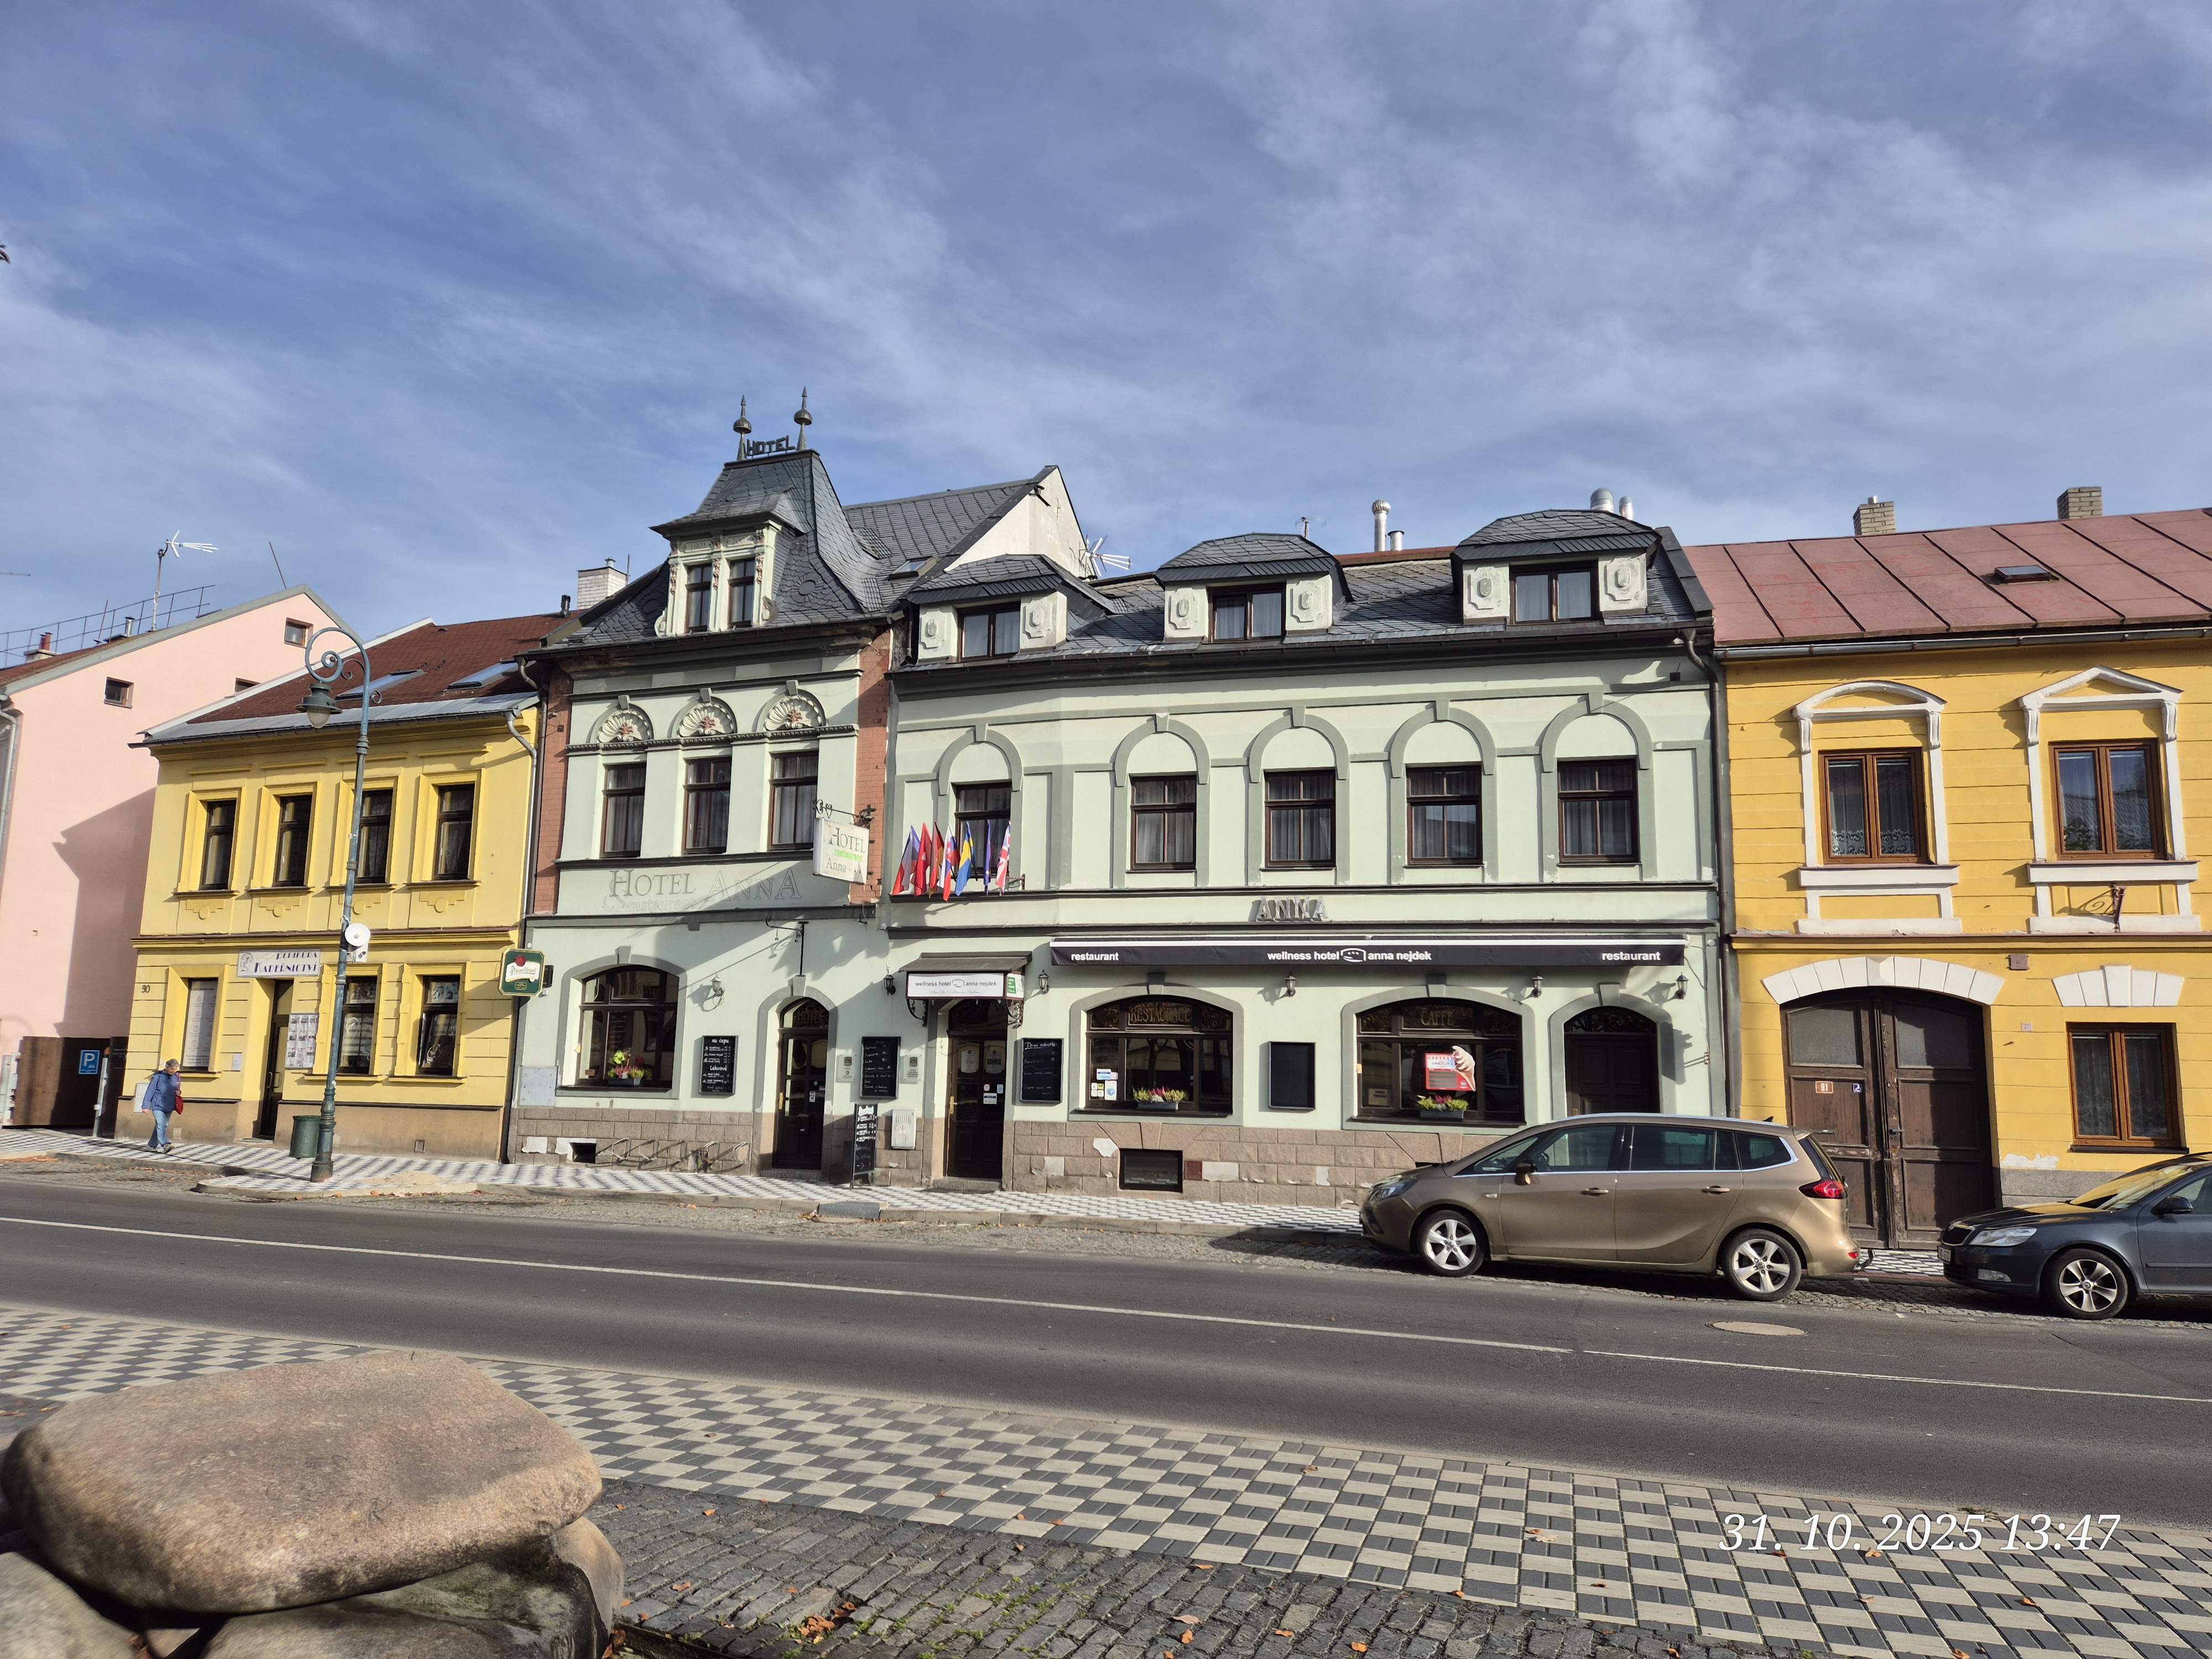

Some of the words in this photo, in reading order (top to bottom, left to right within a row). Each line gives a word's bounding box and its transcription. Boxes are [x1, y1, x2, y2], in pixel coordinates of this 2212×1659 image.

[747, 435, 796, 457] HOTEL
[828, 825, 866, 853] HOTEL
[834, 849, 863, 862] restaurant
[826, 857, 847, 873] Anna
[609, 869, 696, 897] HOTEL
[707, 868, 802, 901] ANNA
[628, 897, 696, 911] restaurant
[1256, 896, 1328, 920] ANNA
[1071, 952, 1119, 961] restaurant
[1267, 951, 1312, 961] wellness
[1313, 951, 1340, 961] hotel
[1368, 952, 1394, 961] anna
[1396, 951, 1432, 962] nejdek
[1601, 951, 1661, 961] restaurant
[254, 962, 317, 973] KADEŘNICTVÍ
[141, 984, 150, 993] 90
[1820, 1083, 1828, 1092] 91
